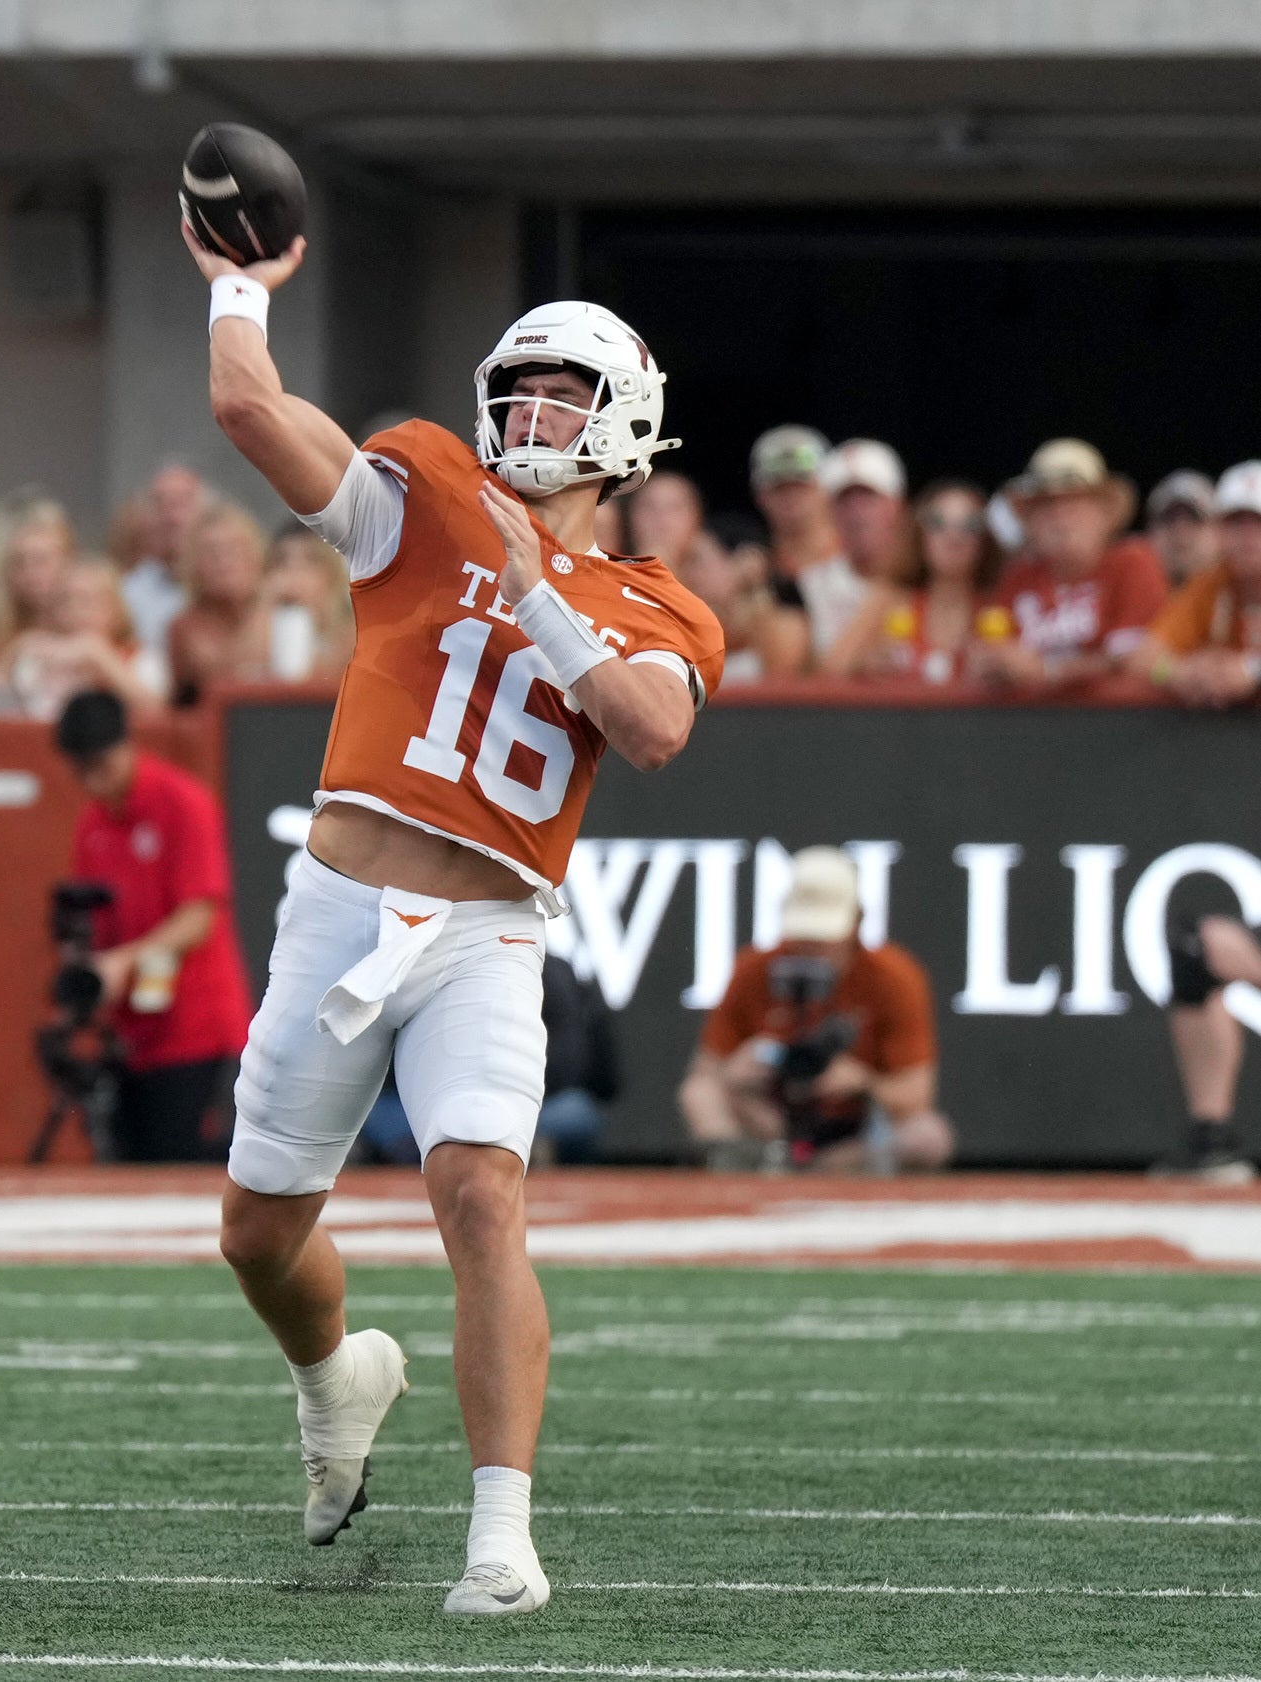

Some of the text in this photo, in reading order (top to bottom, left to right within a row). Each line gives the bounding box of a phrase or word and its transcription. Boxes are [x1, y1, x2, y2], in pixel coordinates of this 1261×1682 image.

[514, 335, 549, 346] HORNS
[552, 555, 573, 573] SEC
[402, 616, 575, 825] 16
